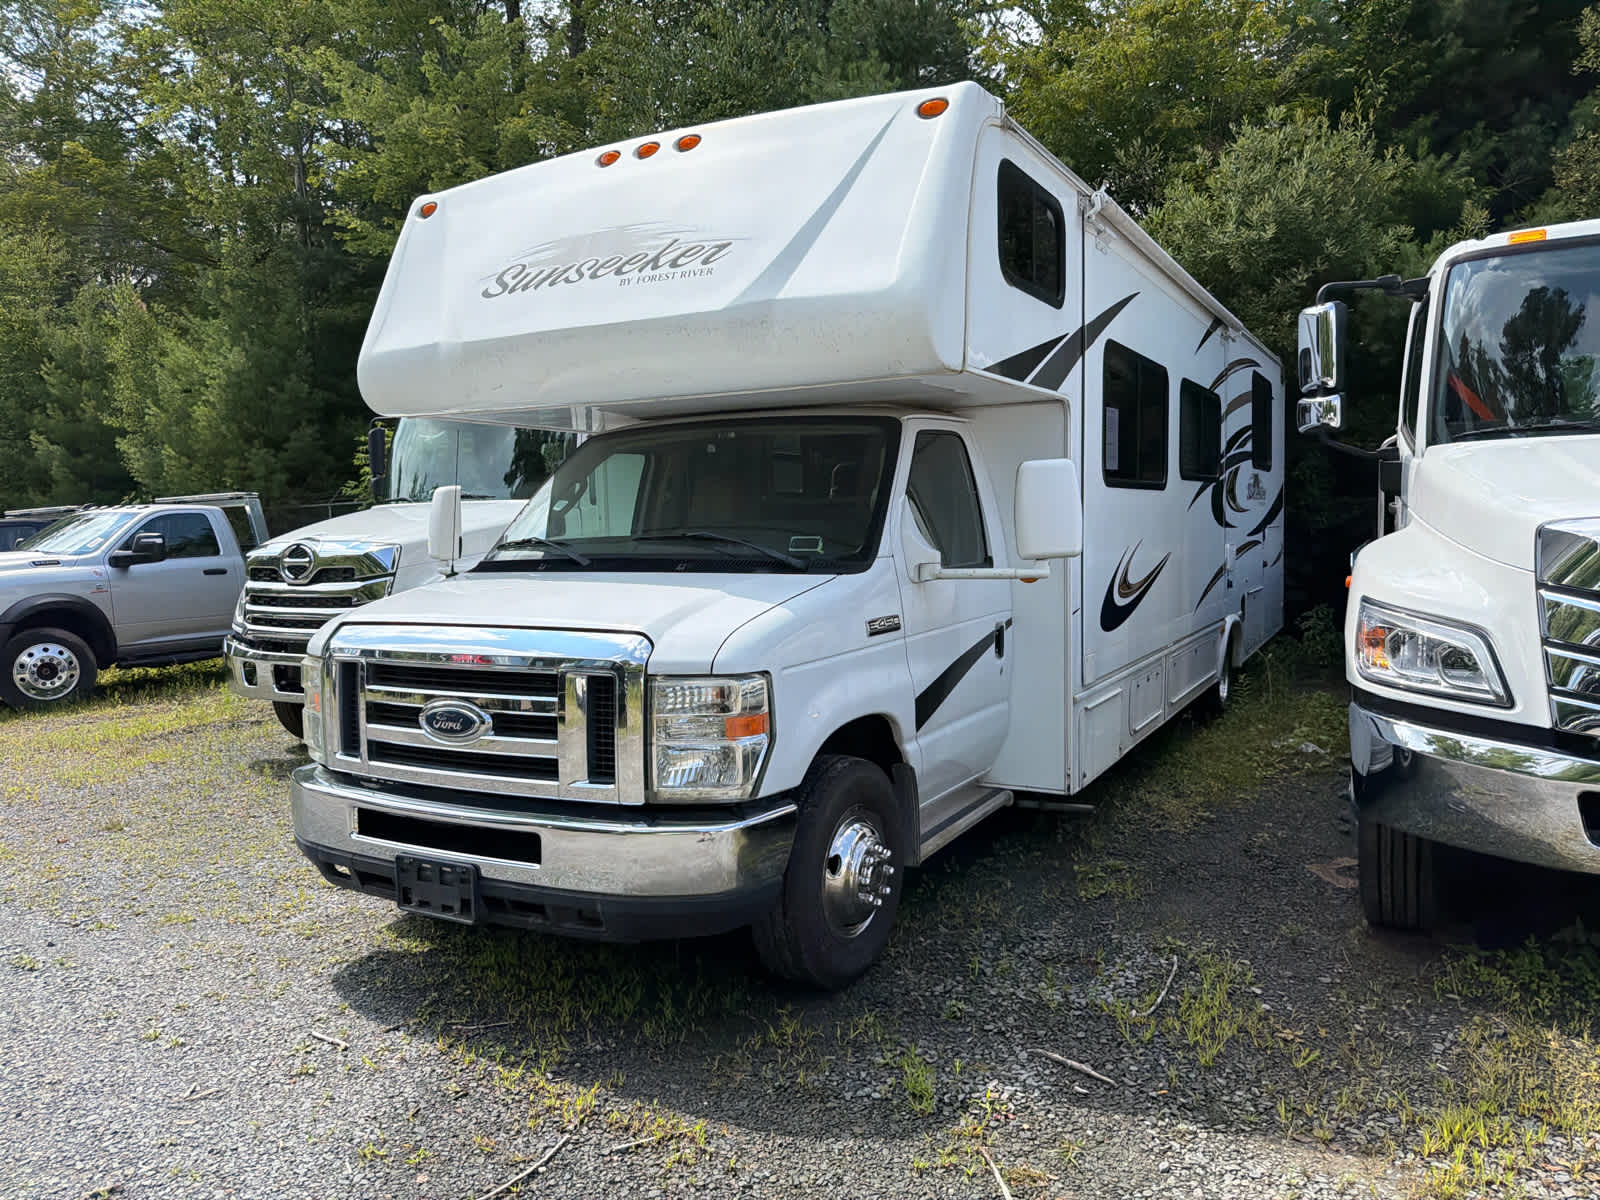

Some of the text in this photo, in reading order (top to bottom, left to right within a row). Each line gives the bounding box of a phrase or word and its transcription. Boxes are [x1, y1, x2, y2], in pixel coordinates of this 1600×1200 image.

[481, 238, 732, 299] Sunseeker
[619, 267, 714, 287] BY FOREST RIVER
[432, 712, 463, 730] Ford
